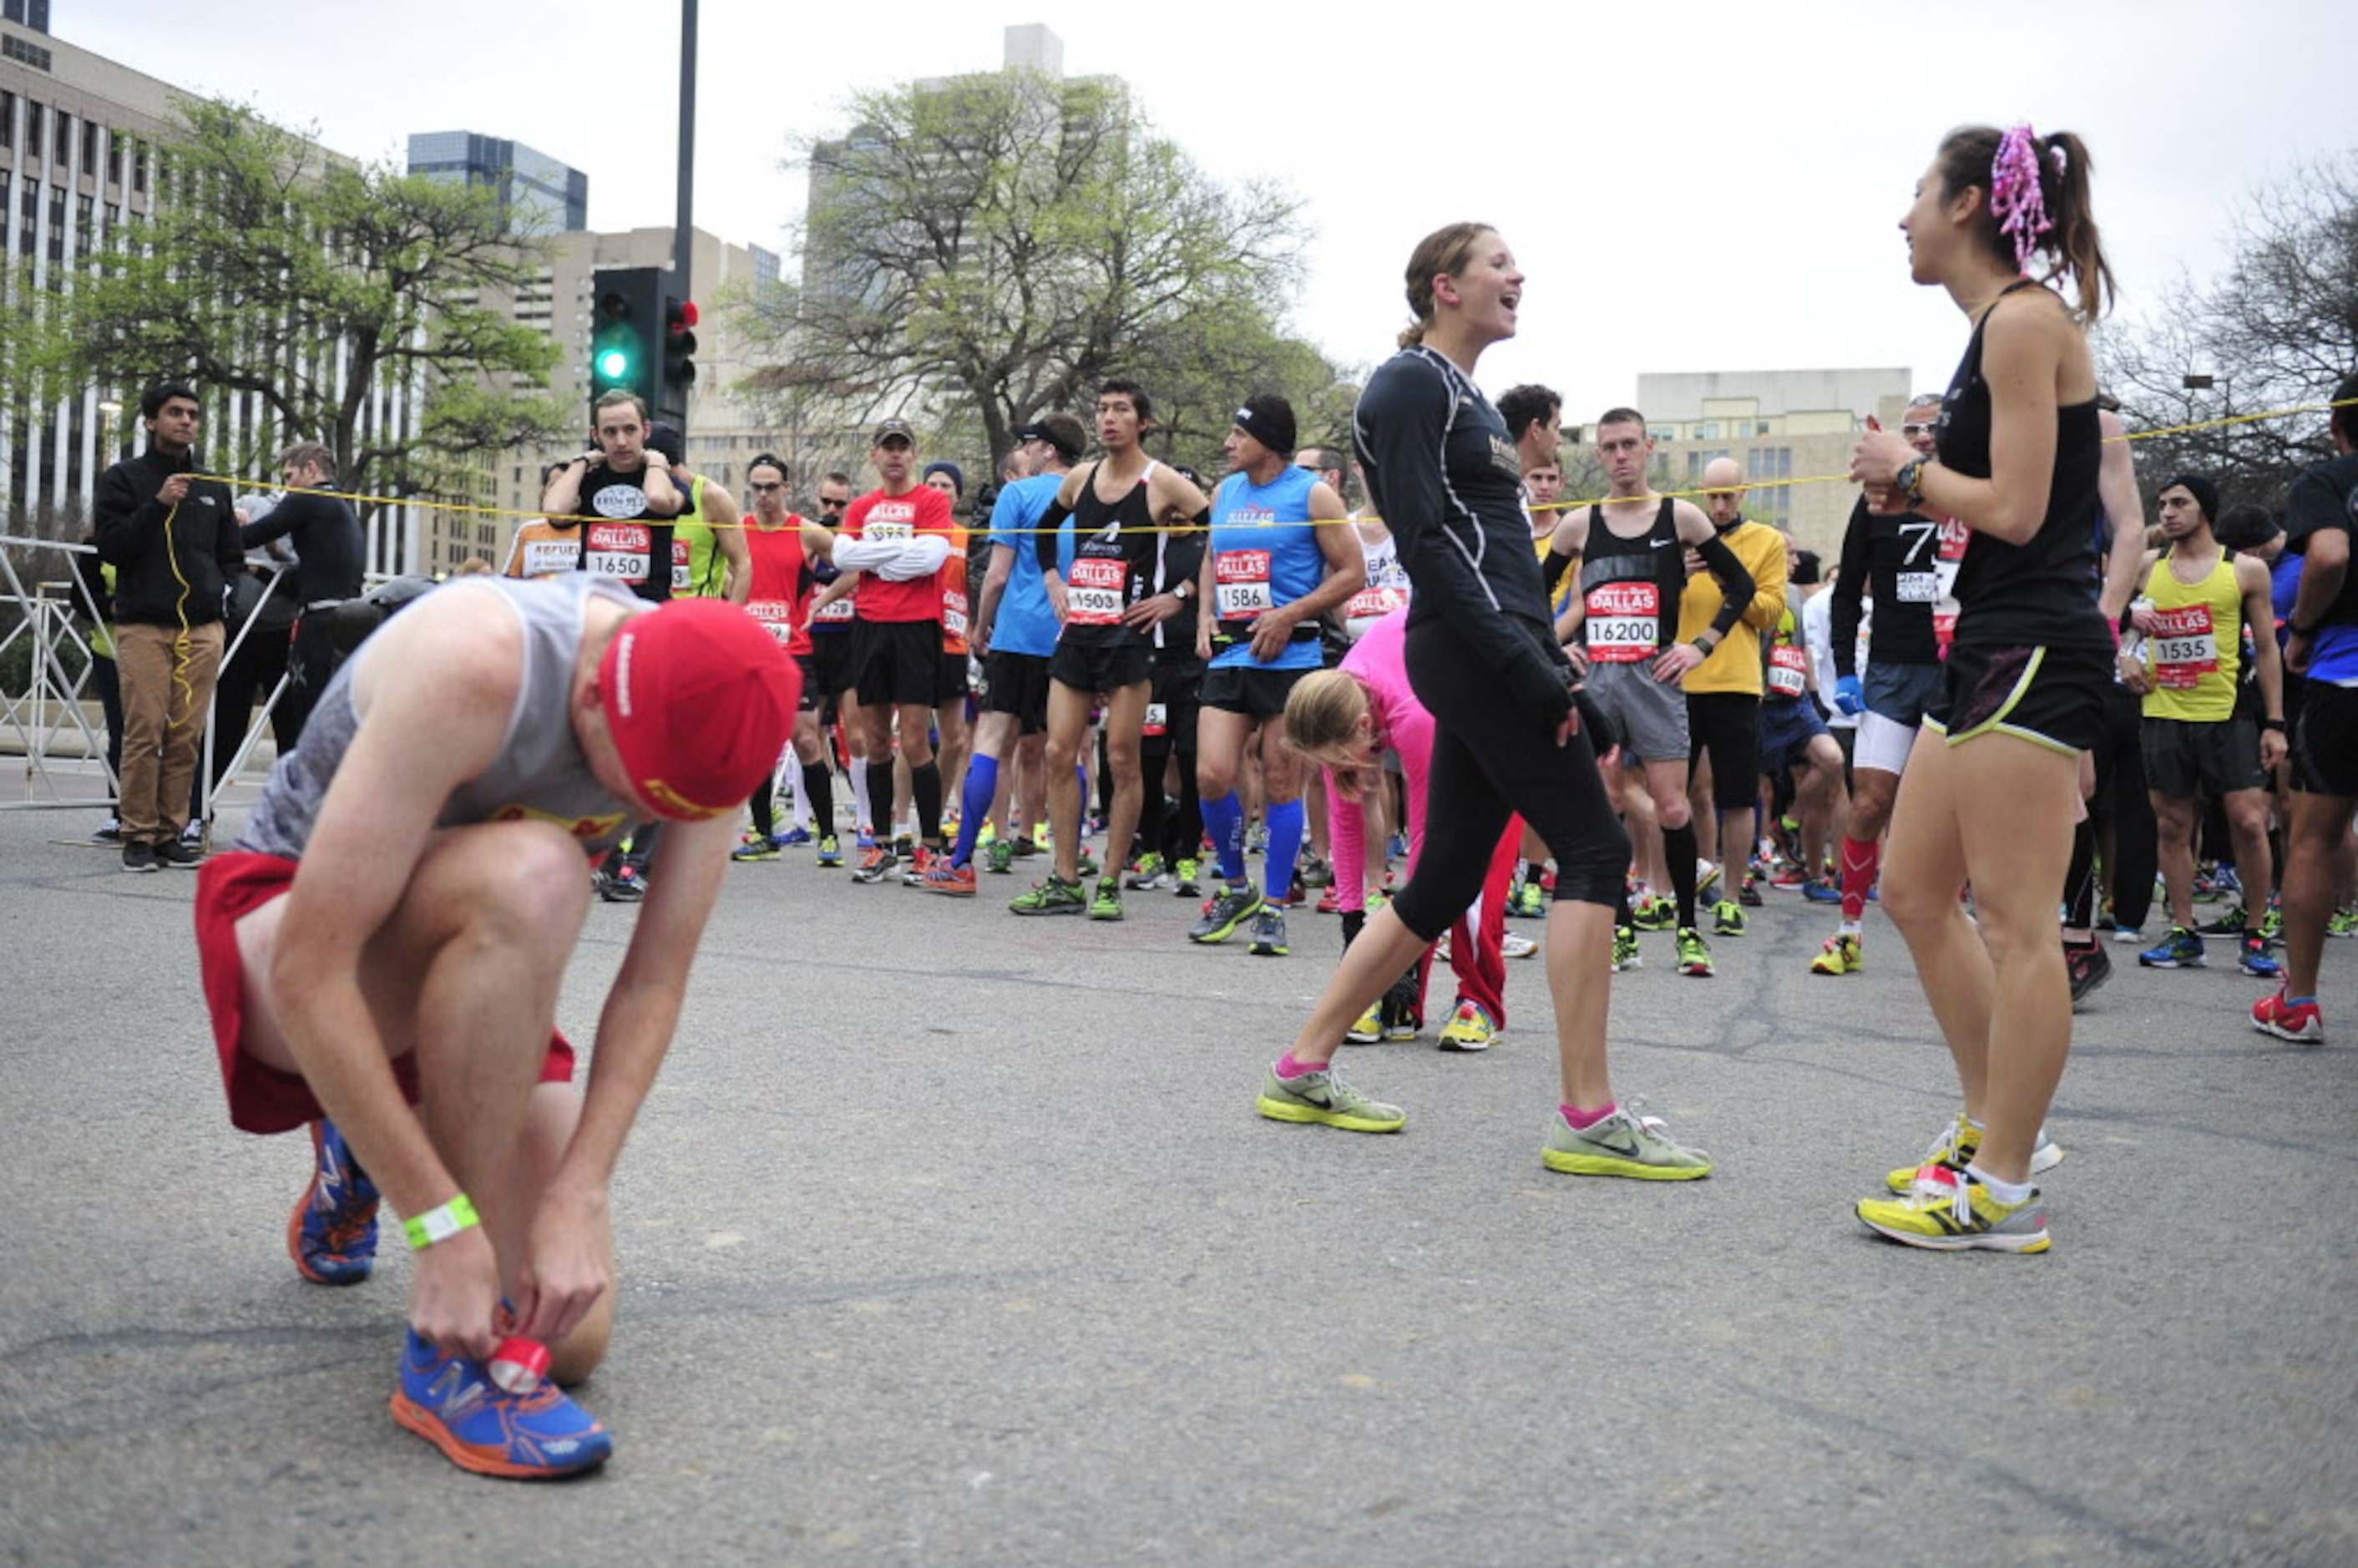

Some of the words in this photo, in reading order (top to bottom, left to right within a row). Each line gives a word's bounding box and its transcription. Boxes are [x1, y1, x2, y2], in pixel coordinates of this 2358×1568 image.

[596, 557, 641, 574] 1650
[1224, 588, 1262, 607] 1586
[1590, 595, 1655, 609] DALLAS
[1592, 622, 1654, 641] 16200
[2159, 640, 2206, 659] 1535
